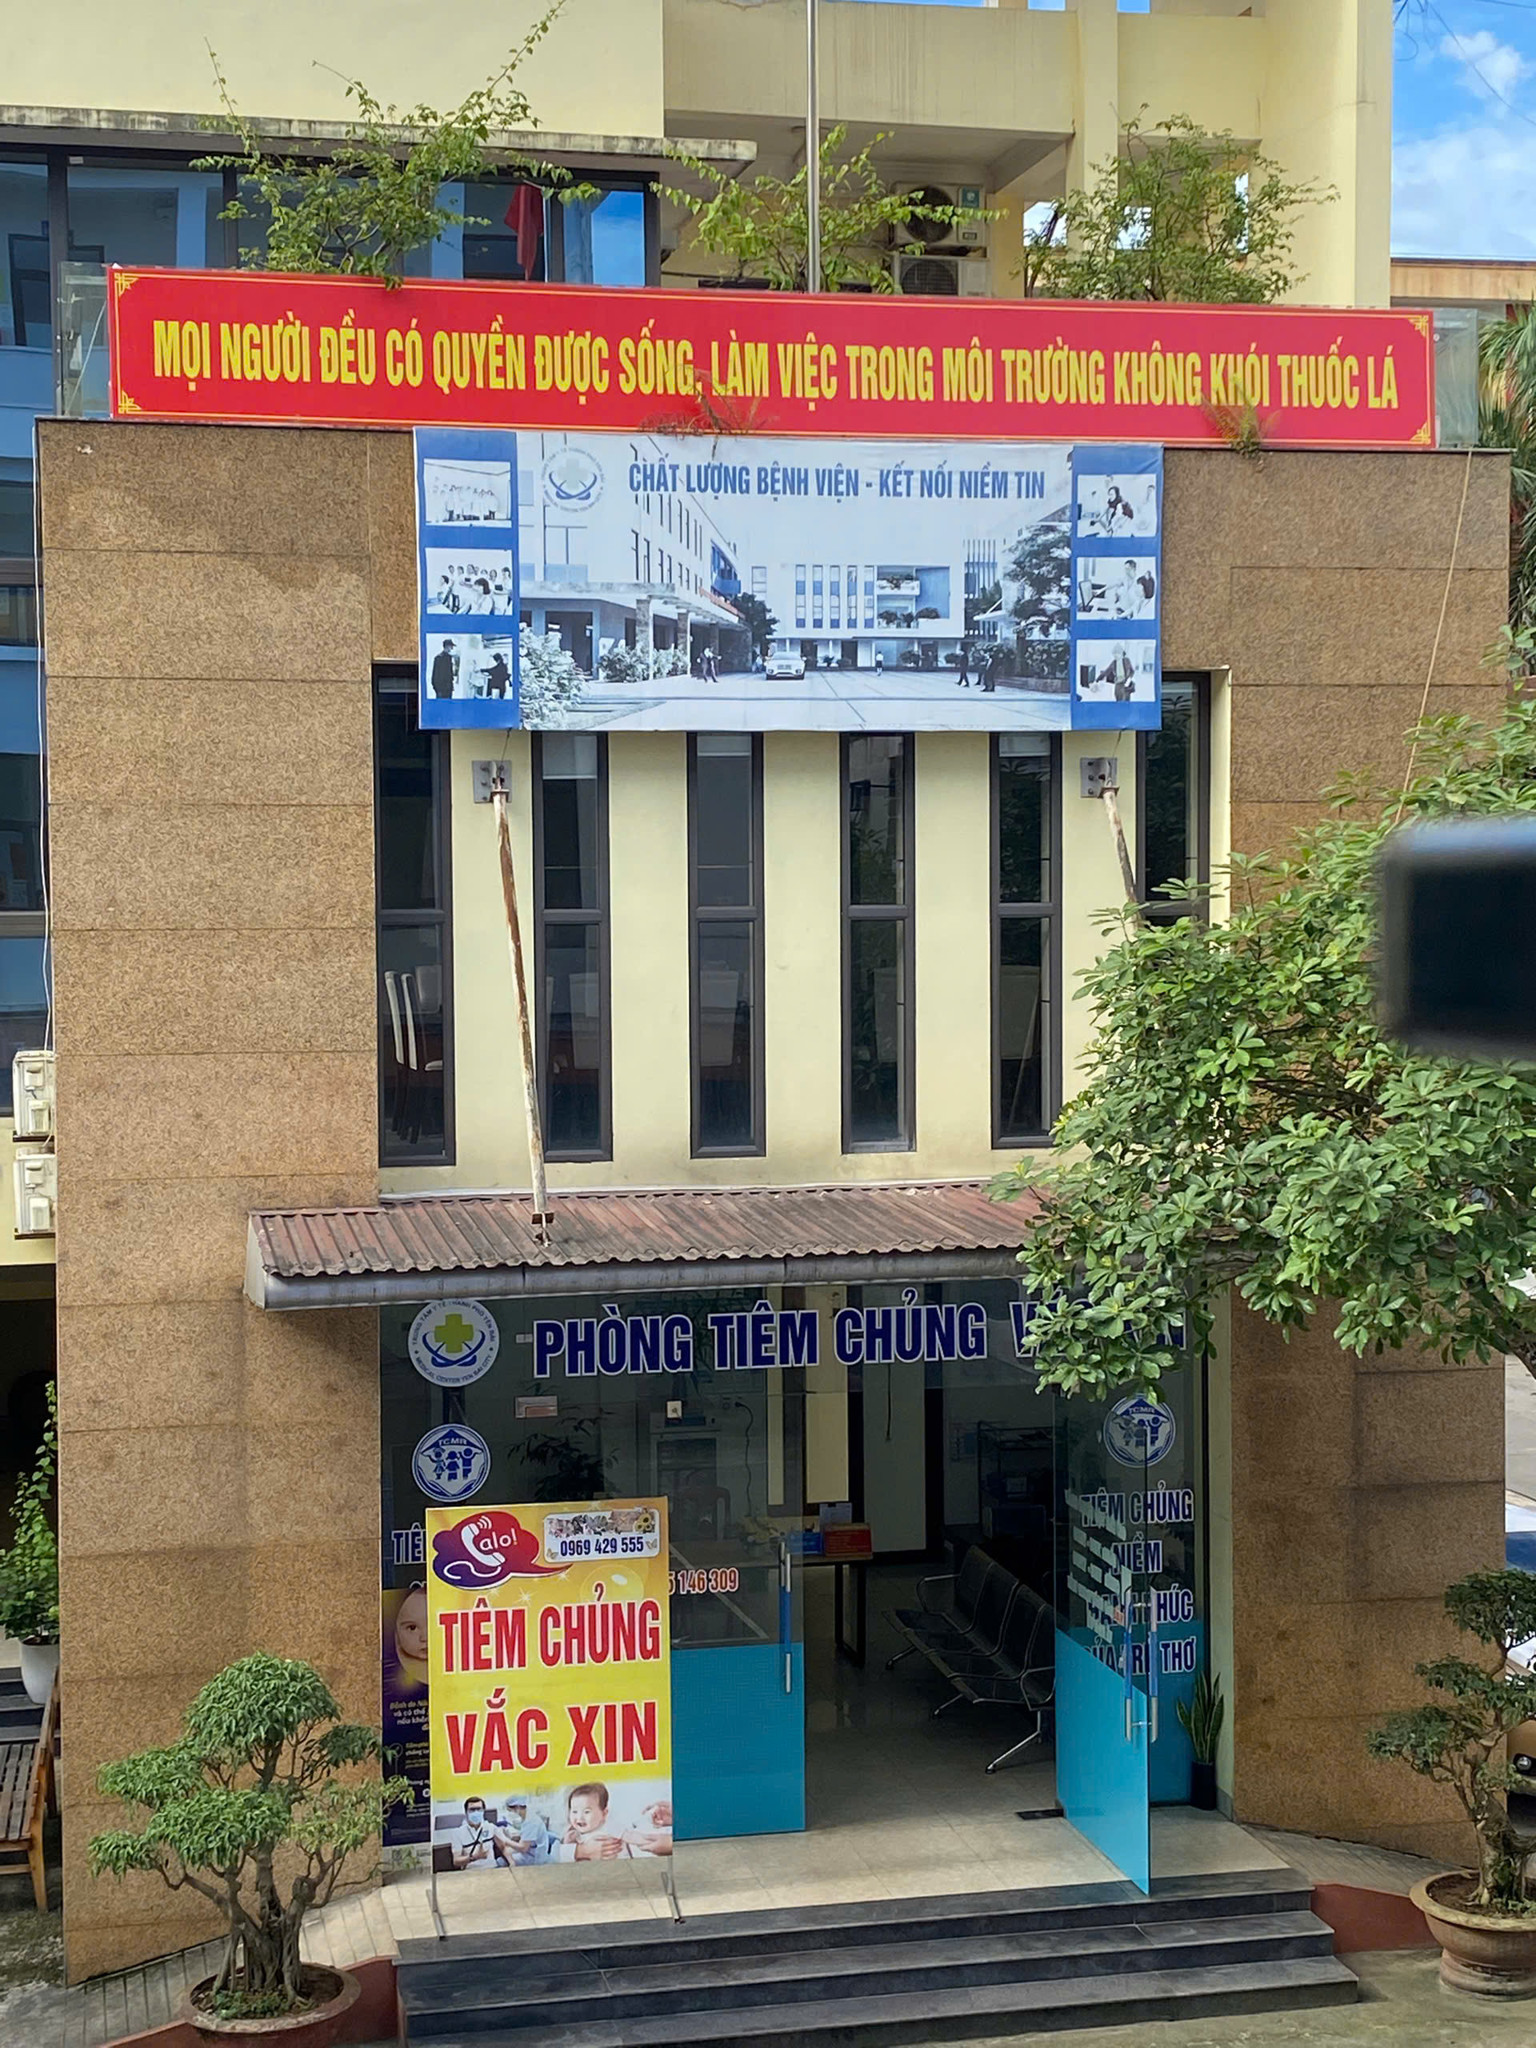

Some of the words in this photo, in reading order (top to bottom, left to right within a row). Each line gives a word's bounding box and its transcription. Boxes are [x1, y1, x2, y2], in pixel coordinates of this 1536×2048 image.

[153, 320, 210, 391] MỌI
[220, 312, 310, 381] NGƯỜI
[319, 309, 376, 386] ĐỀU
[386, 318, 423, 387] CÓ
[433, 314, 525, 396] QUYỀN
[534, 329, 609, 404] ĐƯỢC
[619, 318, 702, 399] SỐNG,
[710, 330, 769, 398] LÀM
[777, 333, 837, 411] VIỆC
[845, 346, 933, 401] TRONG
[942, 337, 992, 402] MÔI
[1001, 337, 1104, 404] TRƯỜNG
[1114, 342, 1203, 406] KHÔNG
[1210, 337, 1270, 408] KHÓI
[1278, 336, 1360, 409] THUỐC
[1368, 347, 1398, 409] LÁ
[628, 456, 680, 497] CHẤT
[686, 461, 751, 504] LƯỢNG
[757, 461, 809, 504] BỆNH
[815, 462, 859, 504] VIỆN
[879, 461, 915, 498] KẾT
[920, 460, 954, 498] NỐI
[959, 461, 1009, 499] NIỀM
[1014, 470, 1045, 499] TIN
[533, 1303, 693, 1378] PHÒNG
[708, 1299, 819, 1369] TIÊM
[835, 1287, 988, 1365] CHỦNG
[1129, 1479, 1194, 1523] CHỦNG
[480, 1527, 519, 1552] alo!
[560, 1539, 590, 1557] 0969
[594, 1538, 617, 1555] 429
[621, 1536, 644, 1553] 555
[1111, 1531, 1163, 1575] NIỀM
[677, 1570, 707, 1595] 146
[709, 1567, 739, 1593] 309
[438, 1597, 527, 1675] TIÊM
[538, 1582, 662, 1667] CHỦNG
[1160, 1636, 1197, 1673] THƠ
[445, 1687, 549, 1775] VẮC
[567, 1701, 658, 1767] XIN
